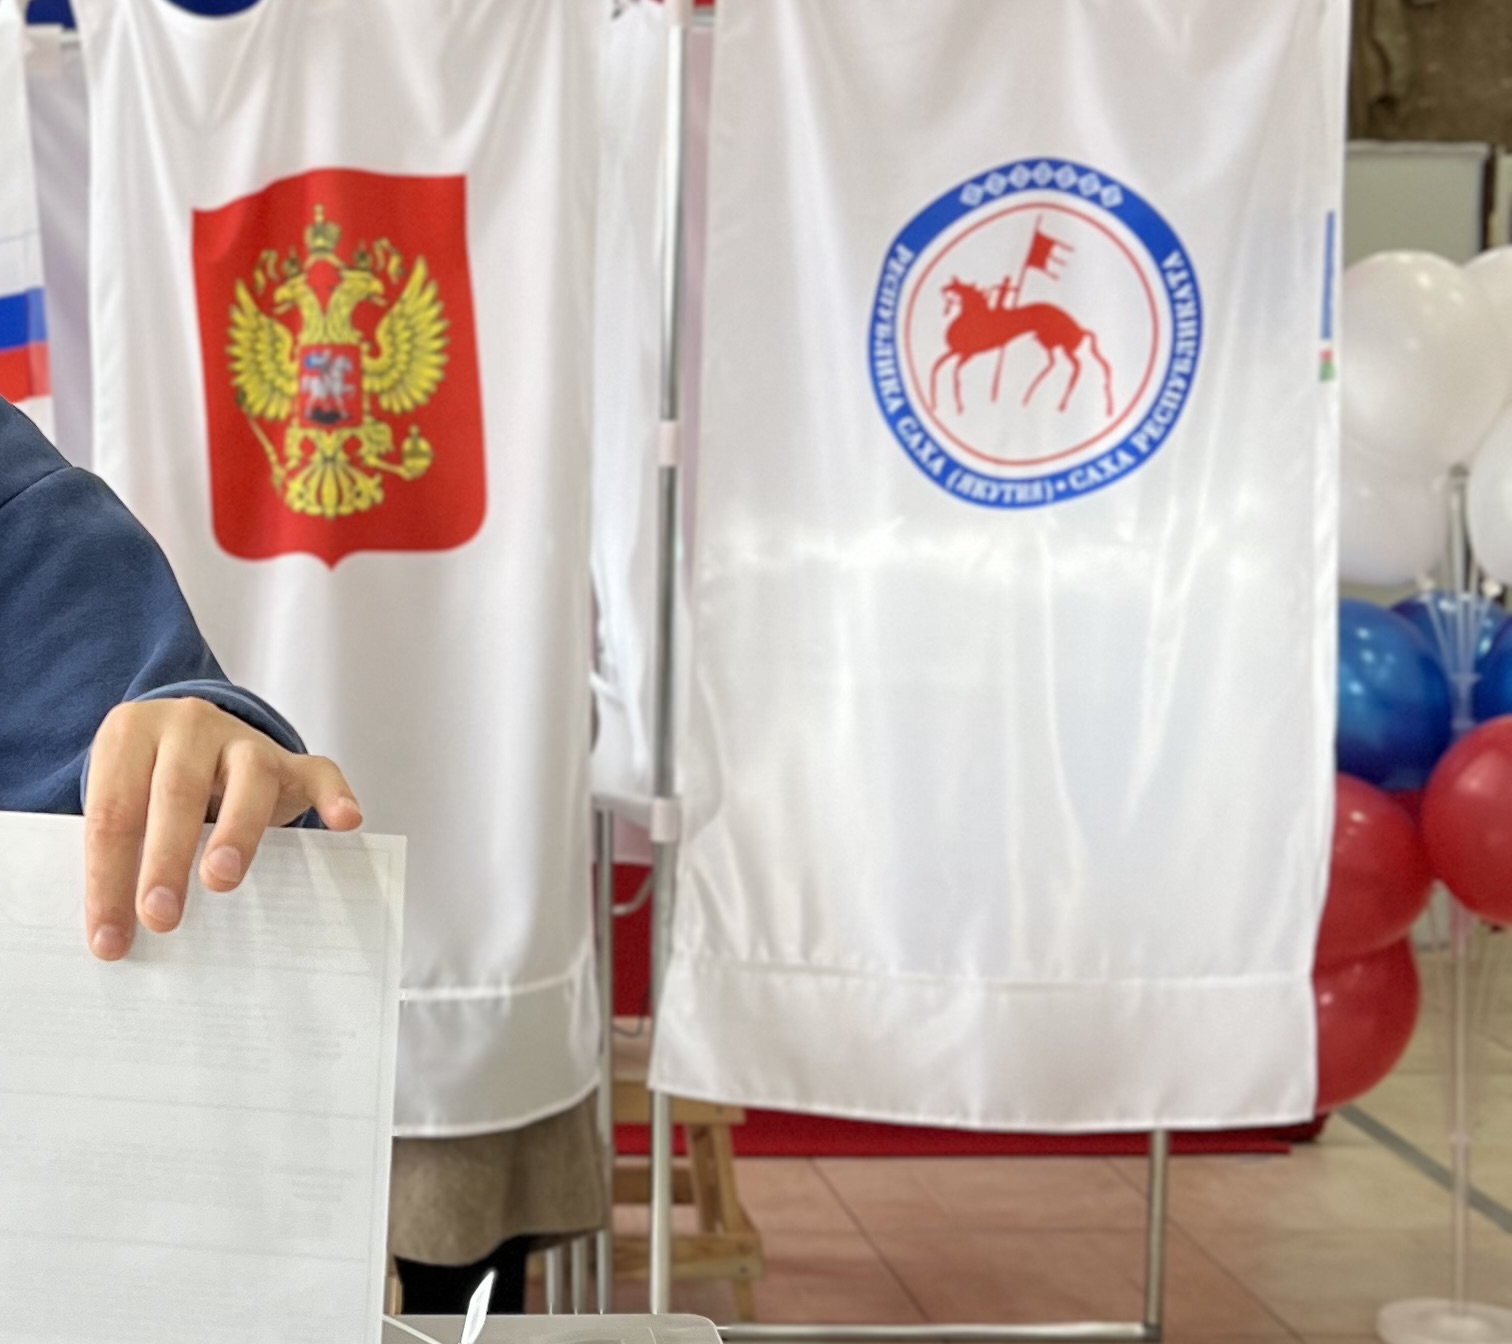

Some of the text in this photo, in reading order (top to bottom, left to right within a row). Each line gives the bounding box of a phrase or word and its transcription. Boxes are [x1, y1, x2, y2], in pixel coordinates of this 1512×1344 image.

[873, 244, 914, 413] РЕСПУБЛИКА
[897, 417, 945, 476] САХА
[1069, 454, 1135, 491] САХА
